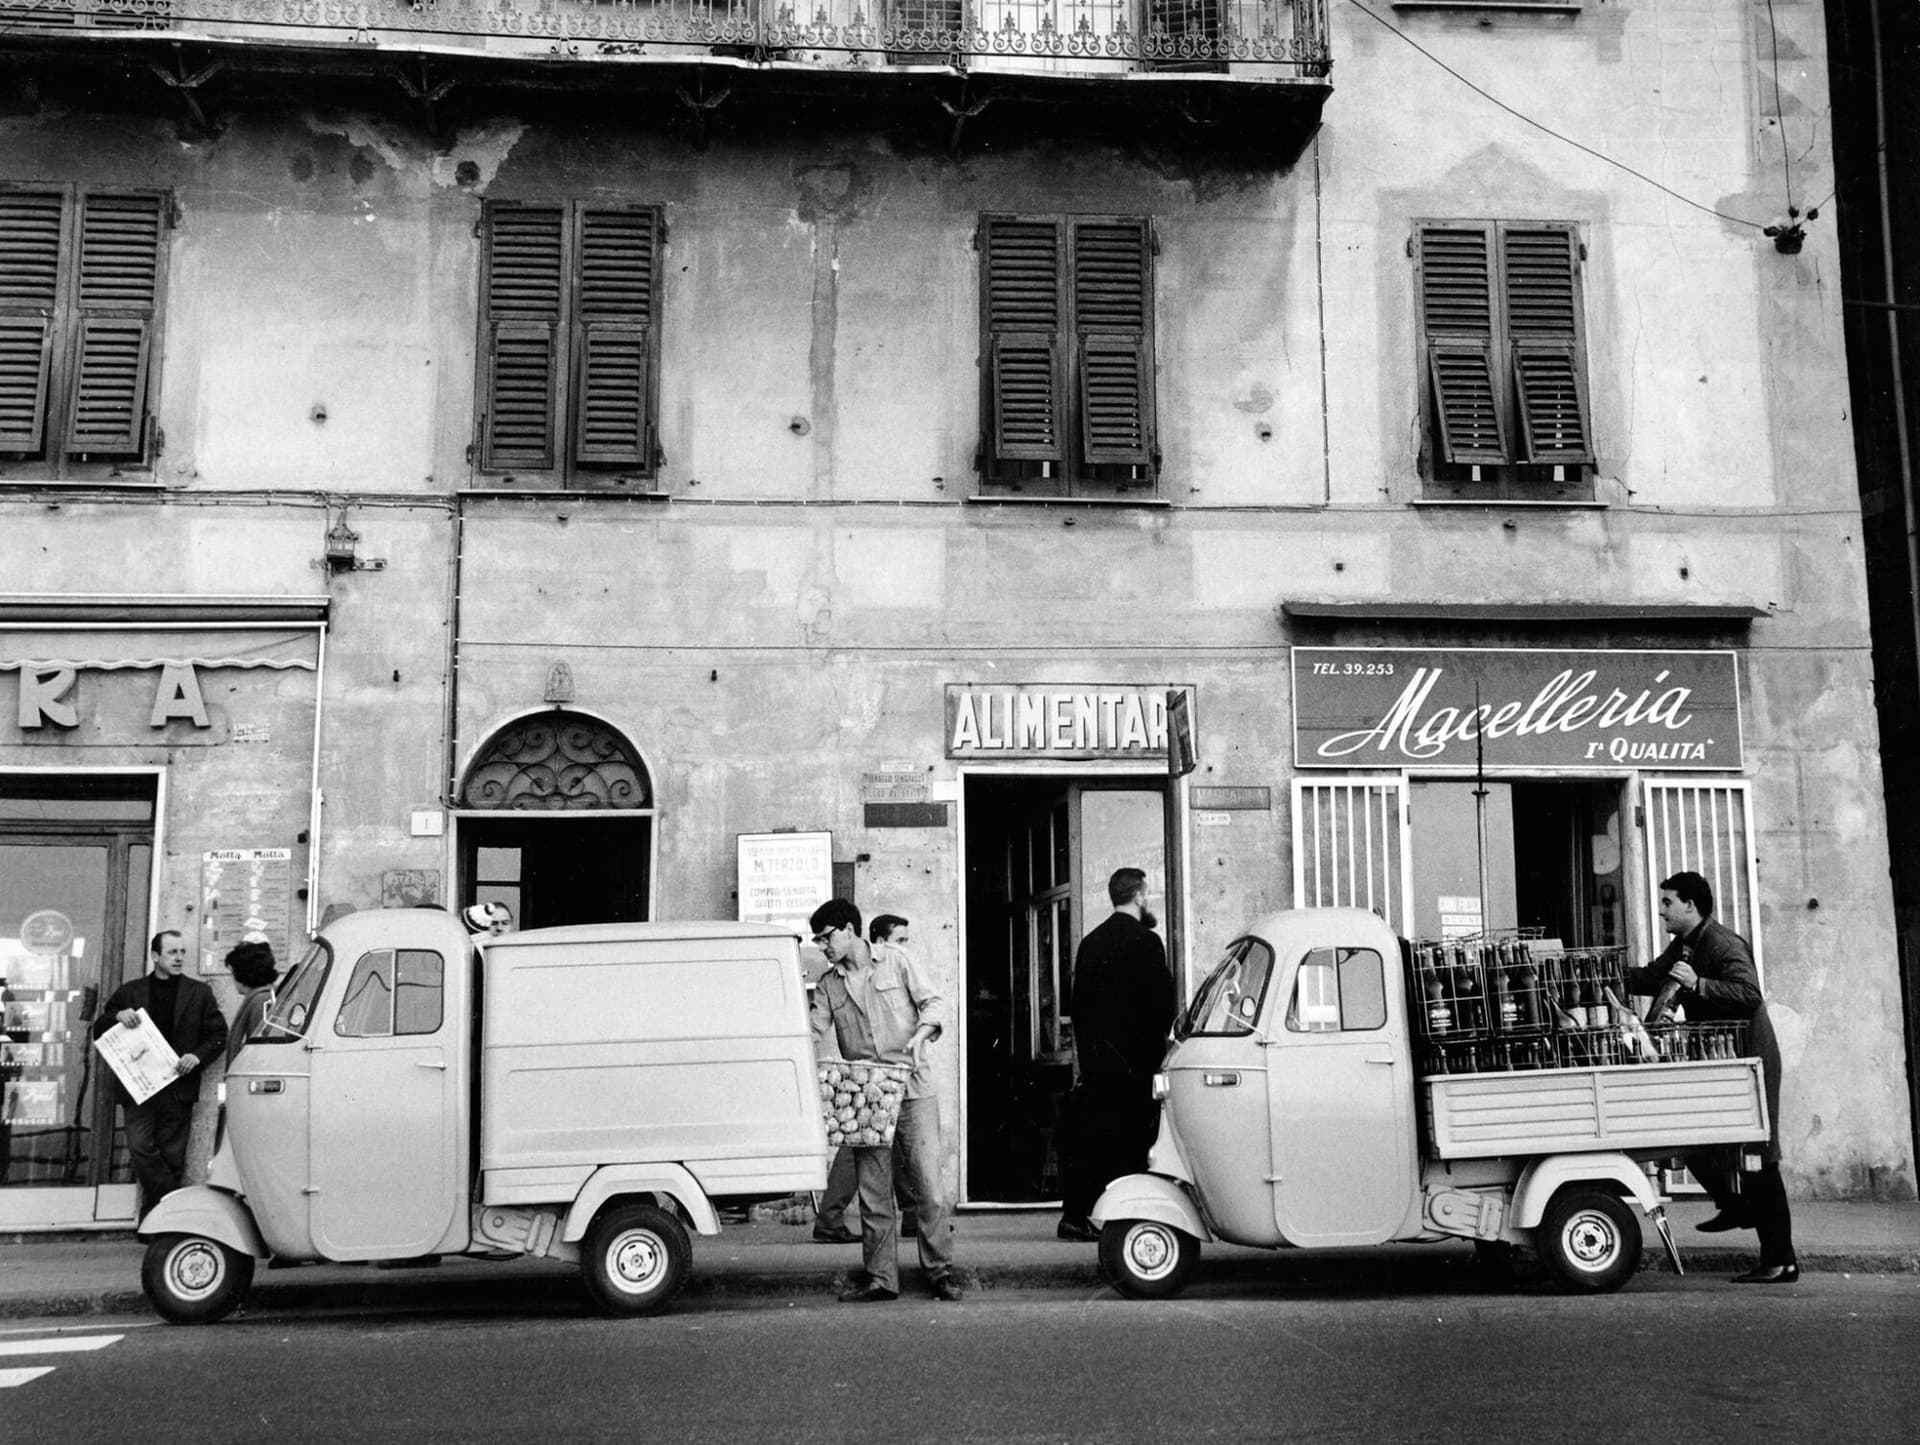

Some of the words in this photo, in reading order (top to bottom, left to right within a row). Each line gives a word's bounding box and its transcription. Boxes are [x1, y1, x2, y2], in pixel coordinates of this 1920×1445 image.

[1343, 663, 1394, 675] 39.253
[952, 692, 1168, 750] ALIMENTAR
[1318, 667, 1693, 759] Macelleria
[254, 850, 285, 859] Motta
